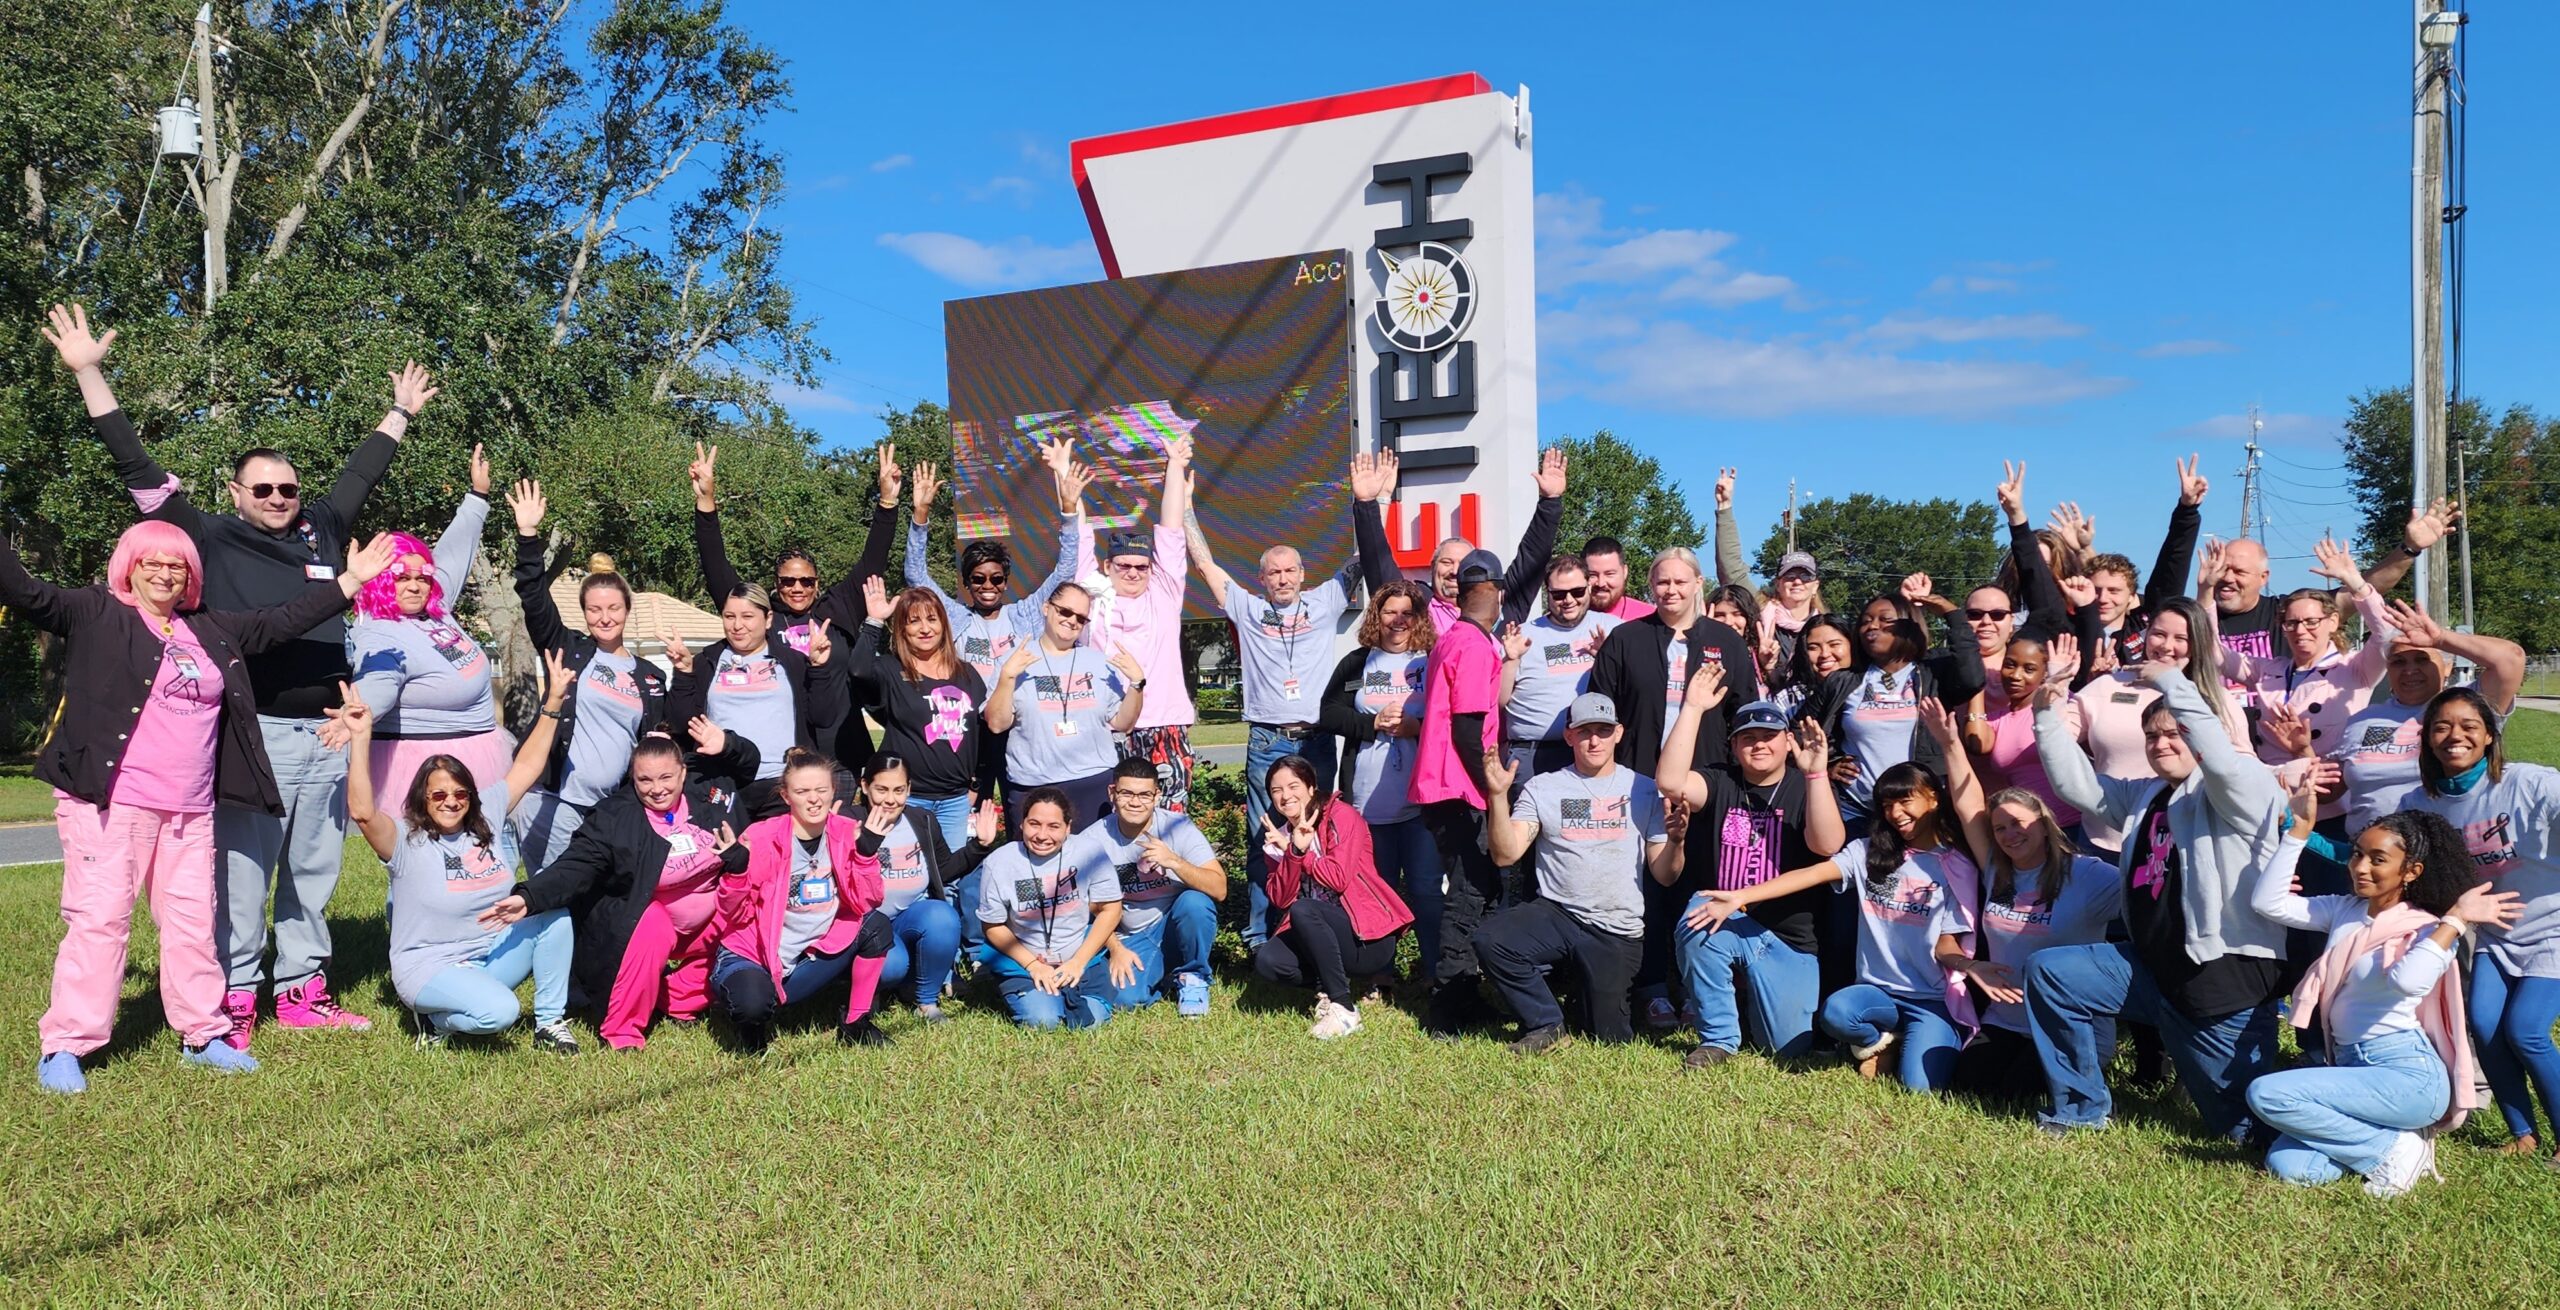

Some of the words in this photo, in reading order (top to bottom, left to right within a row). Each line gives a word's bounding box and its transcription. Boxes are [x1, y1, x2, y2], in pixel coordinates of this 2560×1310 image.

[963, 653, 1000, 667] LAKET
[1548, 653, 1594, 668] LAKETE
[1037, 690, 1096, 702] LAKETECH
[1364, 683, 1424, 696] LAKETECH
[1561, 819, 1628, 830] LAKETECH
[2470, 846, 2517, 866] TECH
[879, 867, 923, 880] KETECH
[1121, 877, 1172, 895] AKETECH
[1018, 890, 1080, 913] LAKETECH
